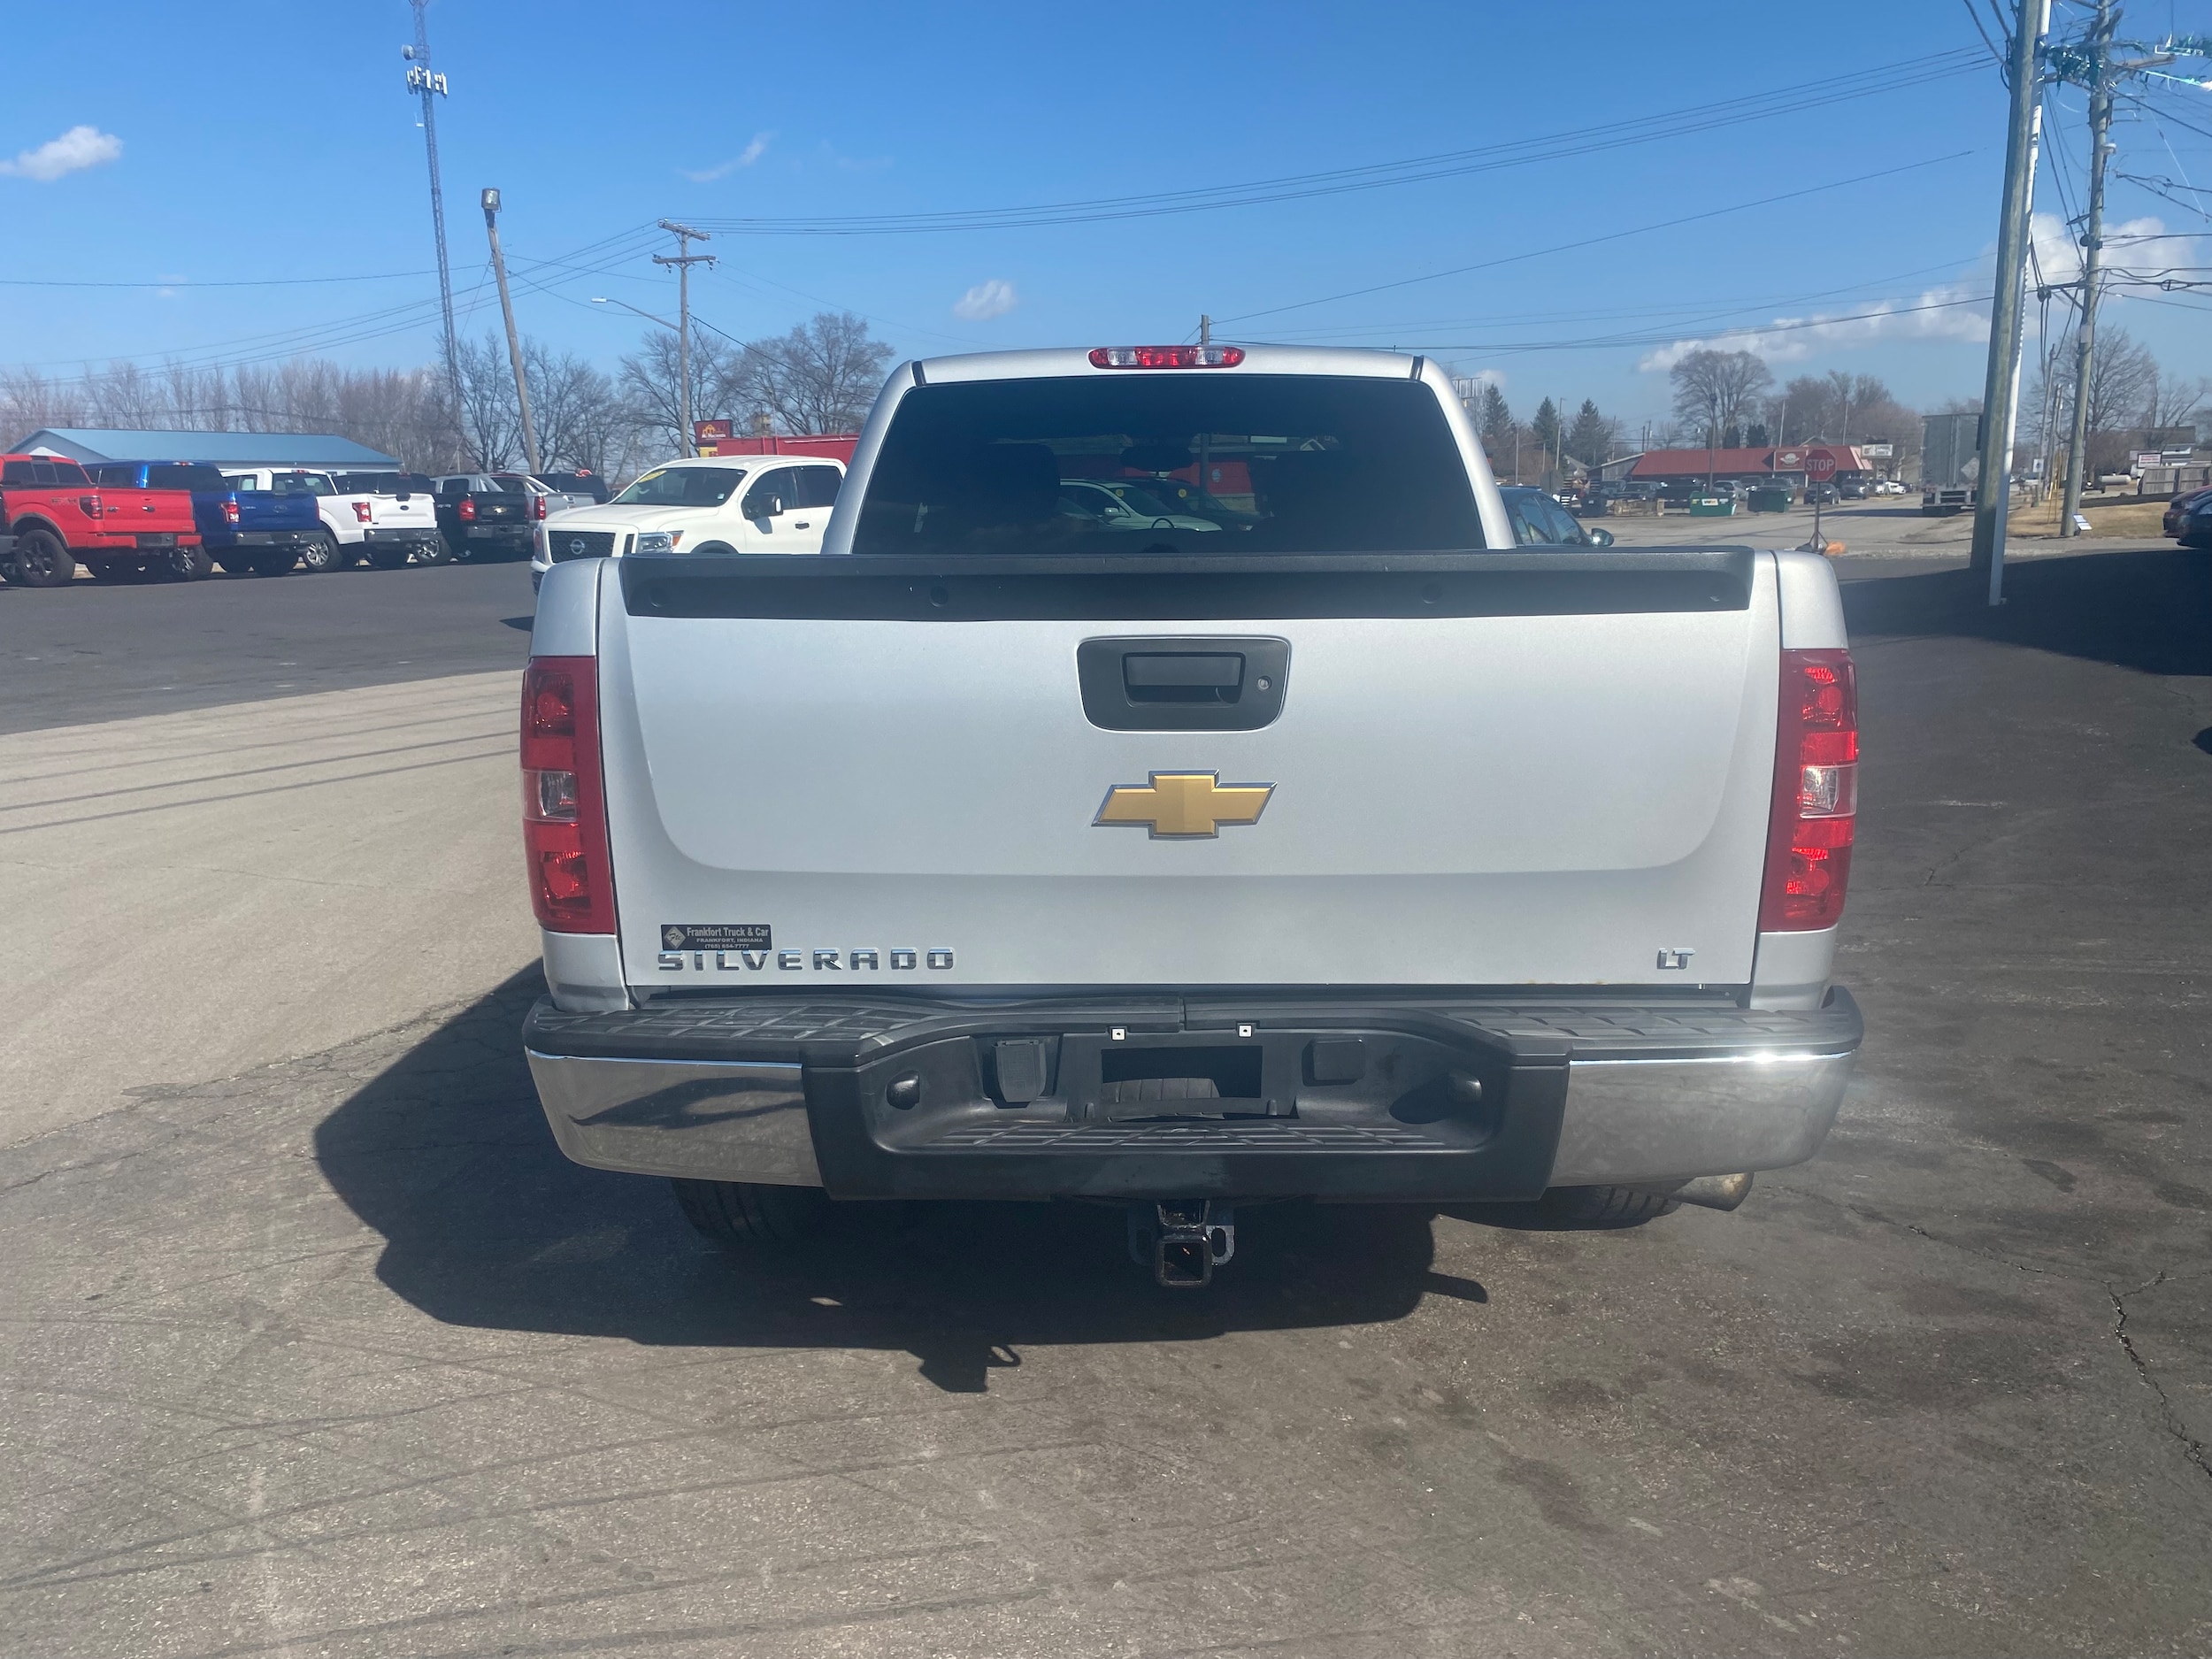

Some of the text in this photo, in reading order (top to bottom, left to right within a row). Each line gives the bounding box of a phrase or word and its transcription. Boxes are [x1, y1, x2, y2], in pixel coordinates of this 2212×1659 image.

[1806, 458, 1834, 472] STOP
[687, 926, 769, 937] Frankfort Truck & Car
[657, 948, 956, 972] SILVERADO
[1656, 948, 1696, 971] LT
